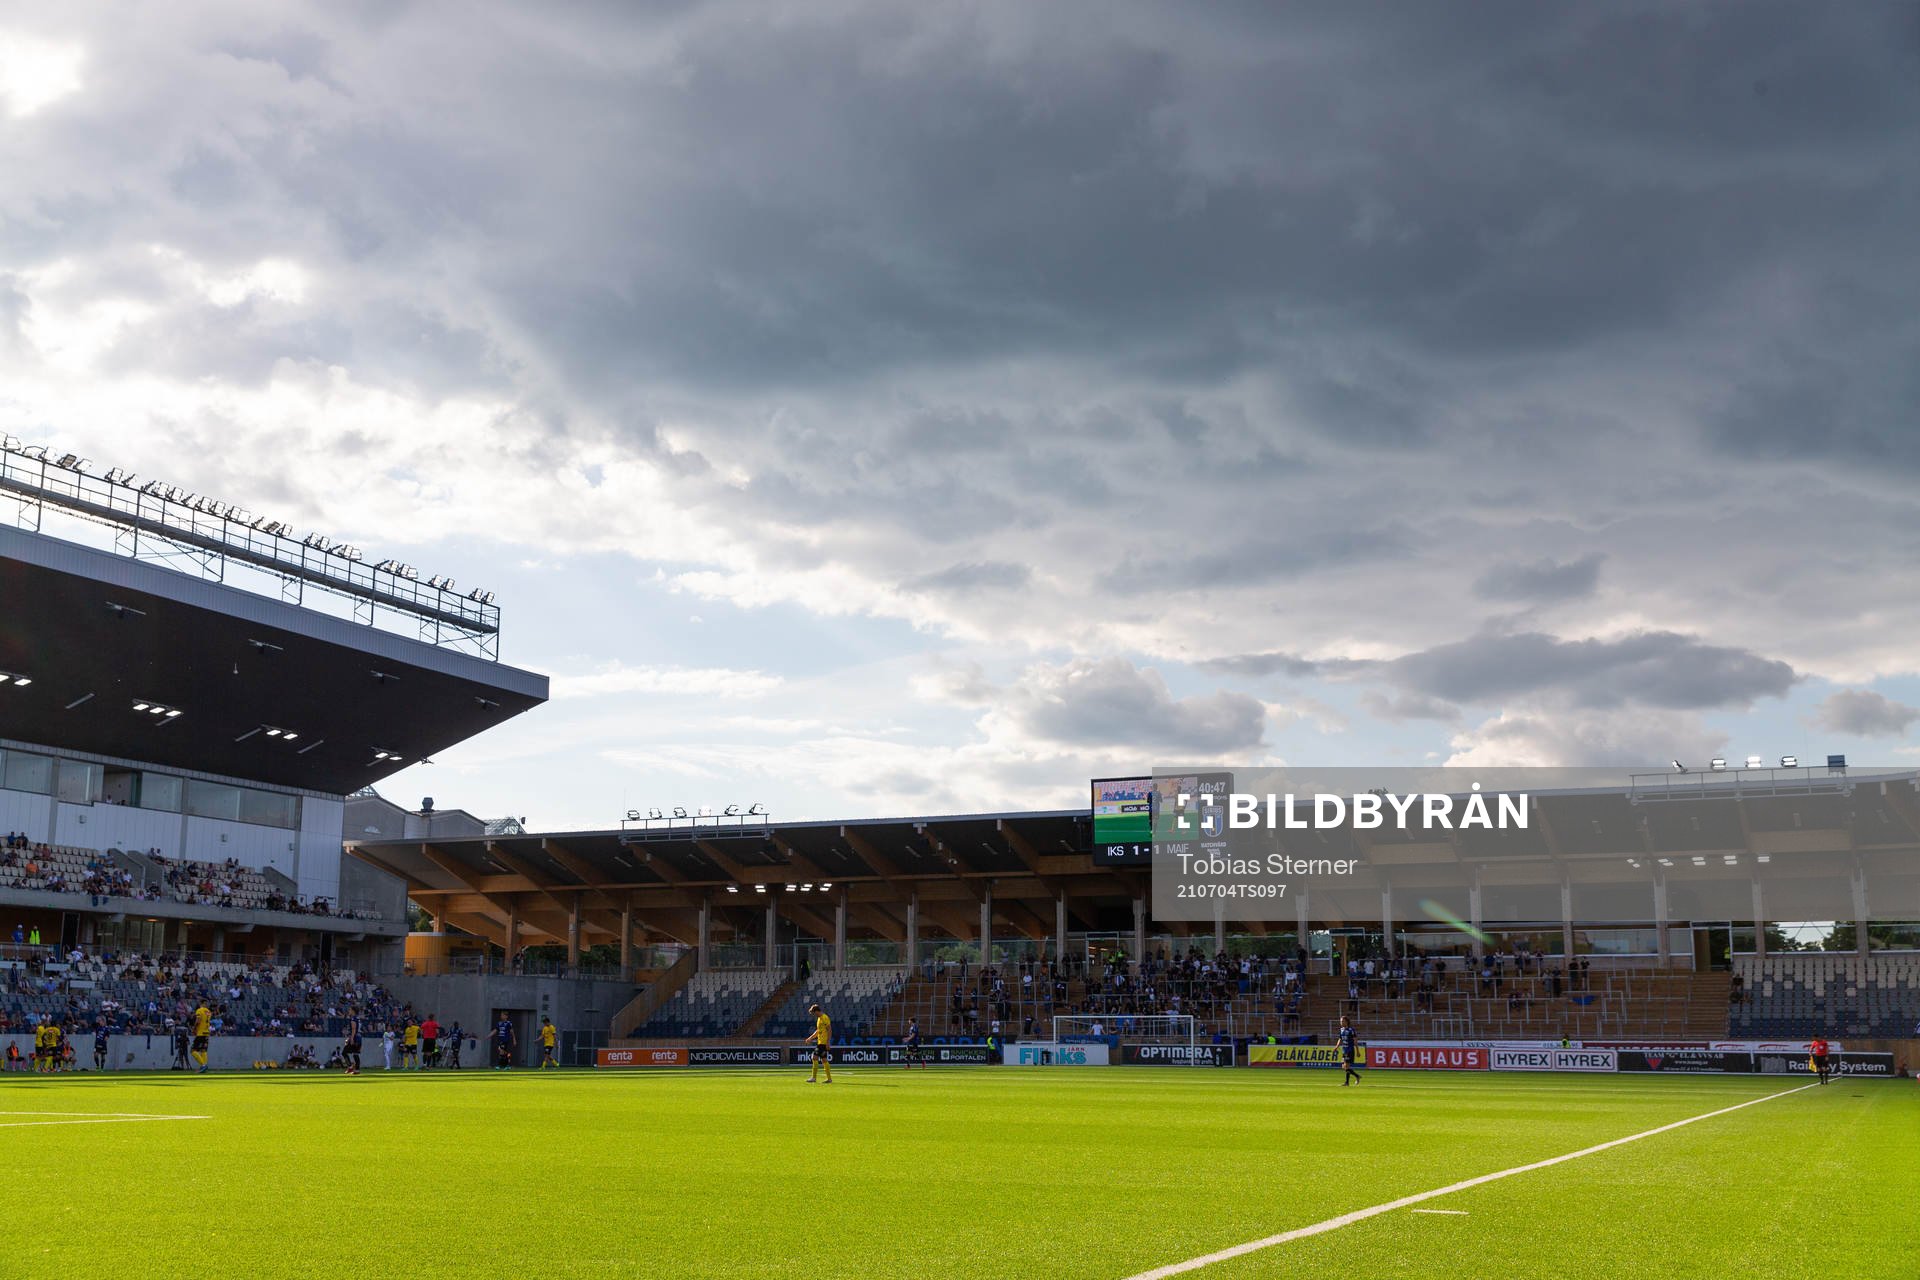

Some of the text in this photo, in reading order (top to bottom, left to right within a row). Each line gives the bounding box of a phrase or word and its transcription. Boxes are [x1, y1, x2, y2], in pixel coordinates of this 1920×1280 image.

[1199, 782, 1225, 793] 40:47
[1107, 846, 1124, 856] IKS
[1132, 845, 1139, 855] 1
[1153, 845, 1160, 854] 1
[1167, 844, 1189, 853] MAIF
[607, 1051, 633, 1061] renta
[652, 1050, 677, 1060] renta
[690, 1051, 779, 1061] NORDICWELLNESS
[842, 1051, 879, 1062] inkClub
[1140, 1047, 1213, 1058] OPTIMERA
[1276, 1047, 1339, 1061] BLÅKLÄDER
[1375, 1051, 1479, 1066] BAUHAUS
[1496, 1053, 1548, 1066] HYREX
[1558, 1054, 1611, 1067] HYREX
[1789, 1060, 1886, 1072] Raiy System
